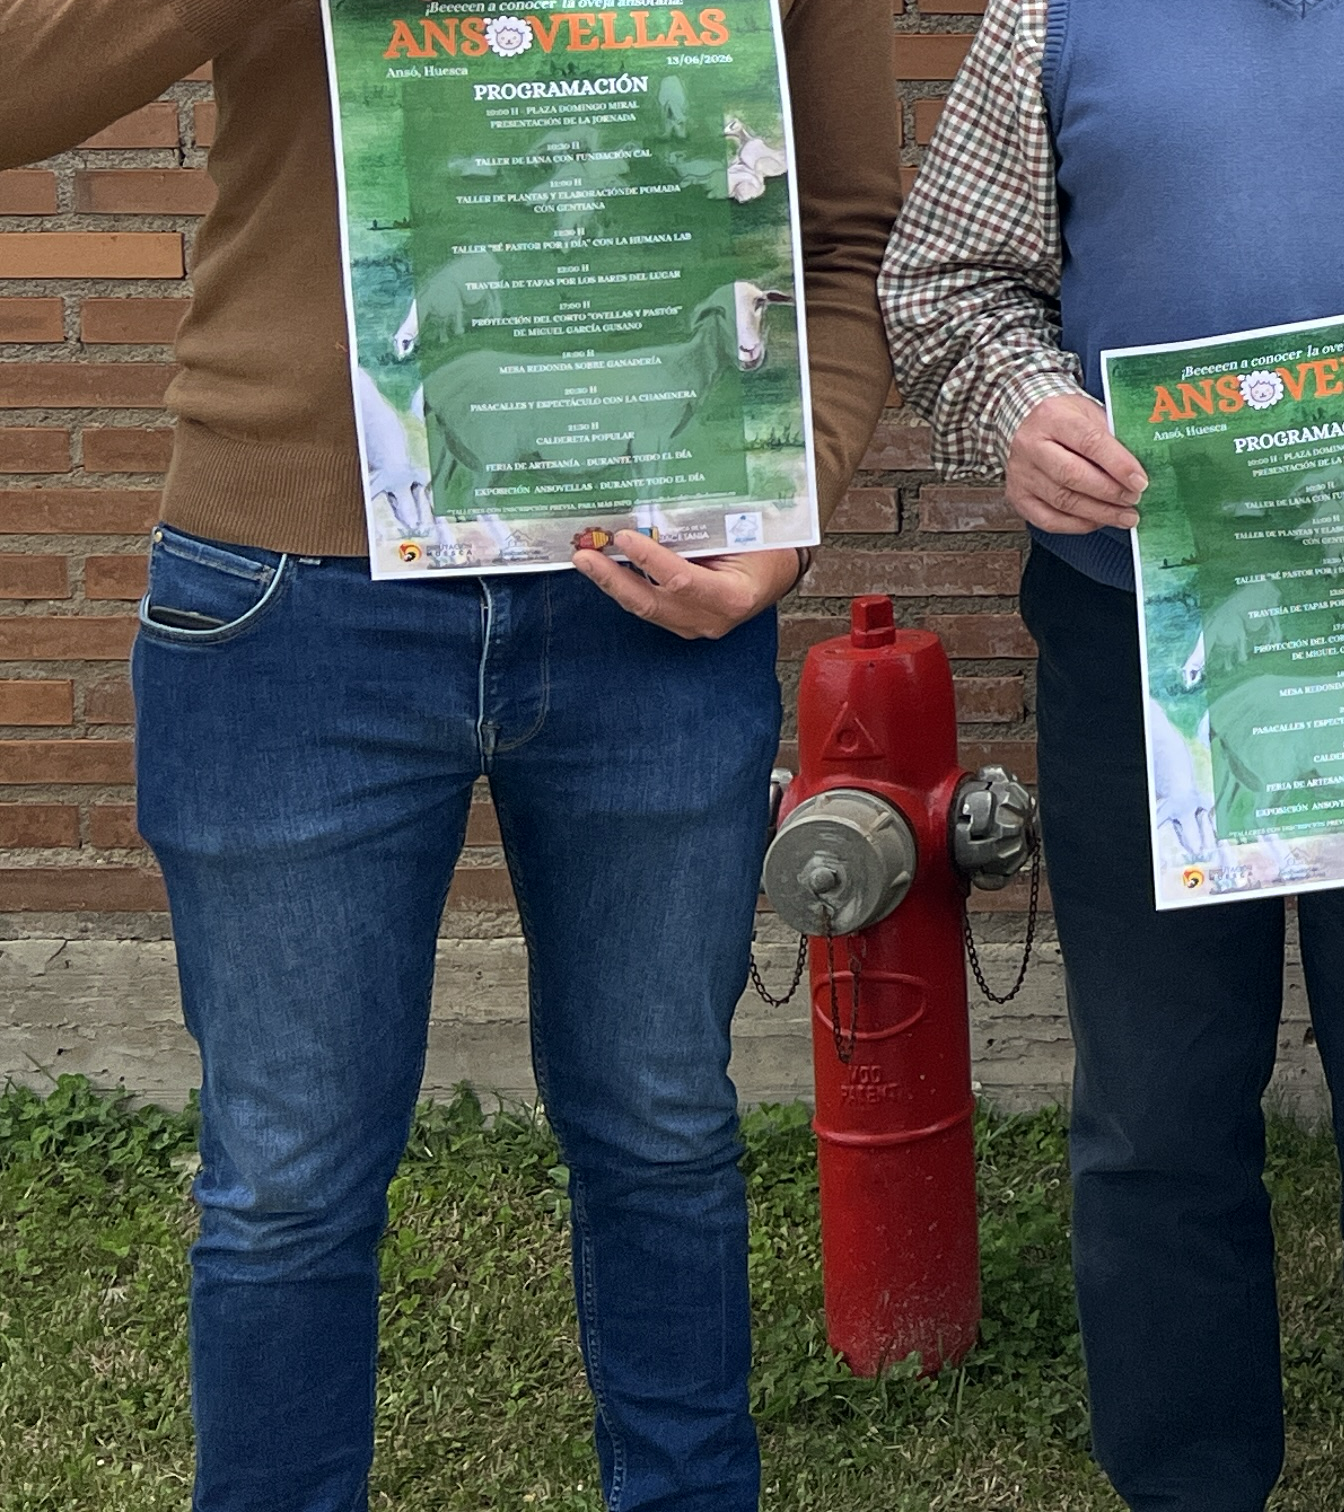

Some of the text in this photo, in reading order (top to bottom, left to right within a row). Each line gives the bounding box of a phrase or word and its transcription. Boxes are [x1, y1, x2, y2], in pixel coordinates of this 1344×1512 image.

[487, 3, 496, 12] a
[666, 54, 733, 66] 13/06/2026
[424, 65, 468, 76] Huesca
[473, 73, 649, 101] PROGRAMACIÓN
[526, 101, 640, 114] PLAZA DOMINGO MIRAL
[490, 117, 561, 129] PRESENTACIÓN
[592, 113, 636, 125] JORNADA
[475, 158, 509, 166] TALLER
[526, 156, 551, 164] LANA
[553, 154, 573, 163] CON
[456, 195, 491, 204] TALLER
[507, 193, 548, 202] PLANTAS
[639, 184, 681, 194] POMADA
[534, 202, 605, 213] CON GENTIANA
[526, 279, 554, 287] TAPAS
[556, 277, 575, 286] POR
[577, 276, 596, 285] LOS
[597, 274, 627, 283] BARES
[629, 273, 646, 281] DEL
[649, 270, 681, 280] LUGAR
[533, 315, 550, 324] DEL
[552, 314, 586, 323] CORTO
[528, 327, 563, 336] MIGUEL
[566, 323, 601, 334] GARCÍA
[1240, 360, 1248, 368] a
[1251, 350, 1302, 367] conocer
[1307, 345, 1319, 358] la
[499, 366, 525, 374] MESA
[527, 363, 572, 373] REDONDA
[574, 361, 603, 370] SOBRE
[470, 402, 527, 412] PASACALLES
[536, 397, 601, 409] ESPECTÁCULO
[603, 396, 623, 405] CON
[1185, 424, 1227, 436] Huesca
[536, 431, 635, 445] CALDERETA POPULAR
[486, 463, 512, 472] FERIA
[529, 458, 579, 469] ARTESANÍA
[587, 456, 630, 466] DURANTE
[633, 453, 660, 463] TODO
[675, 449, 692, 459] DÍA
